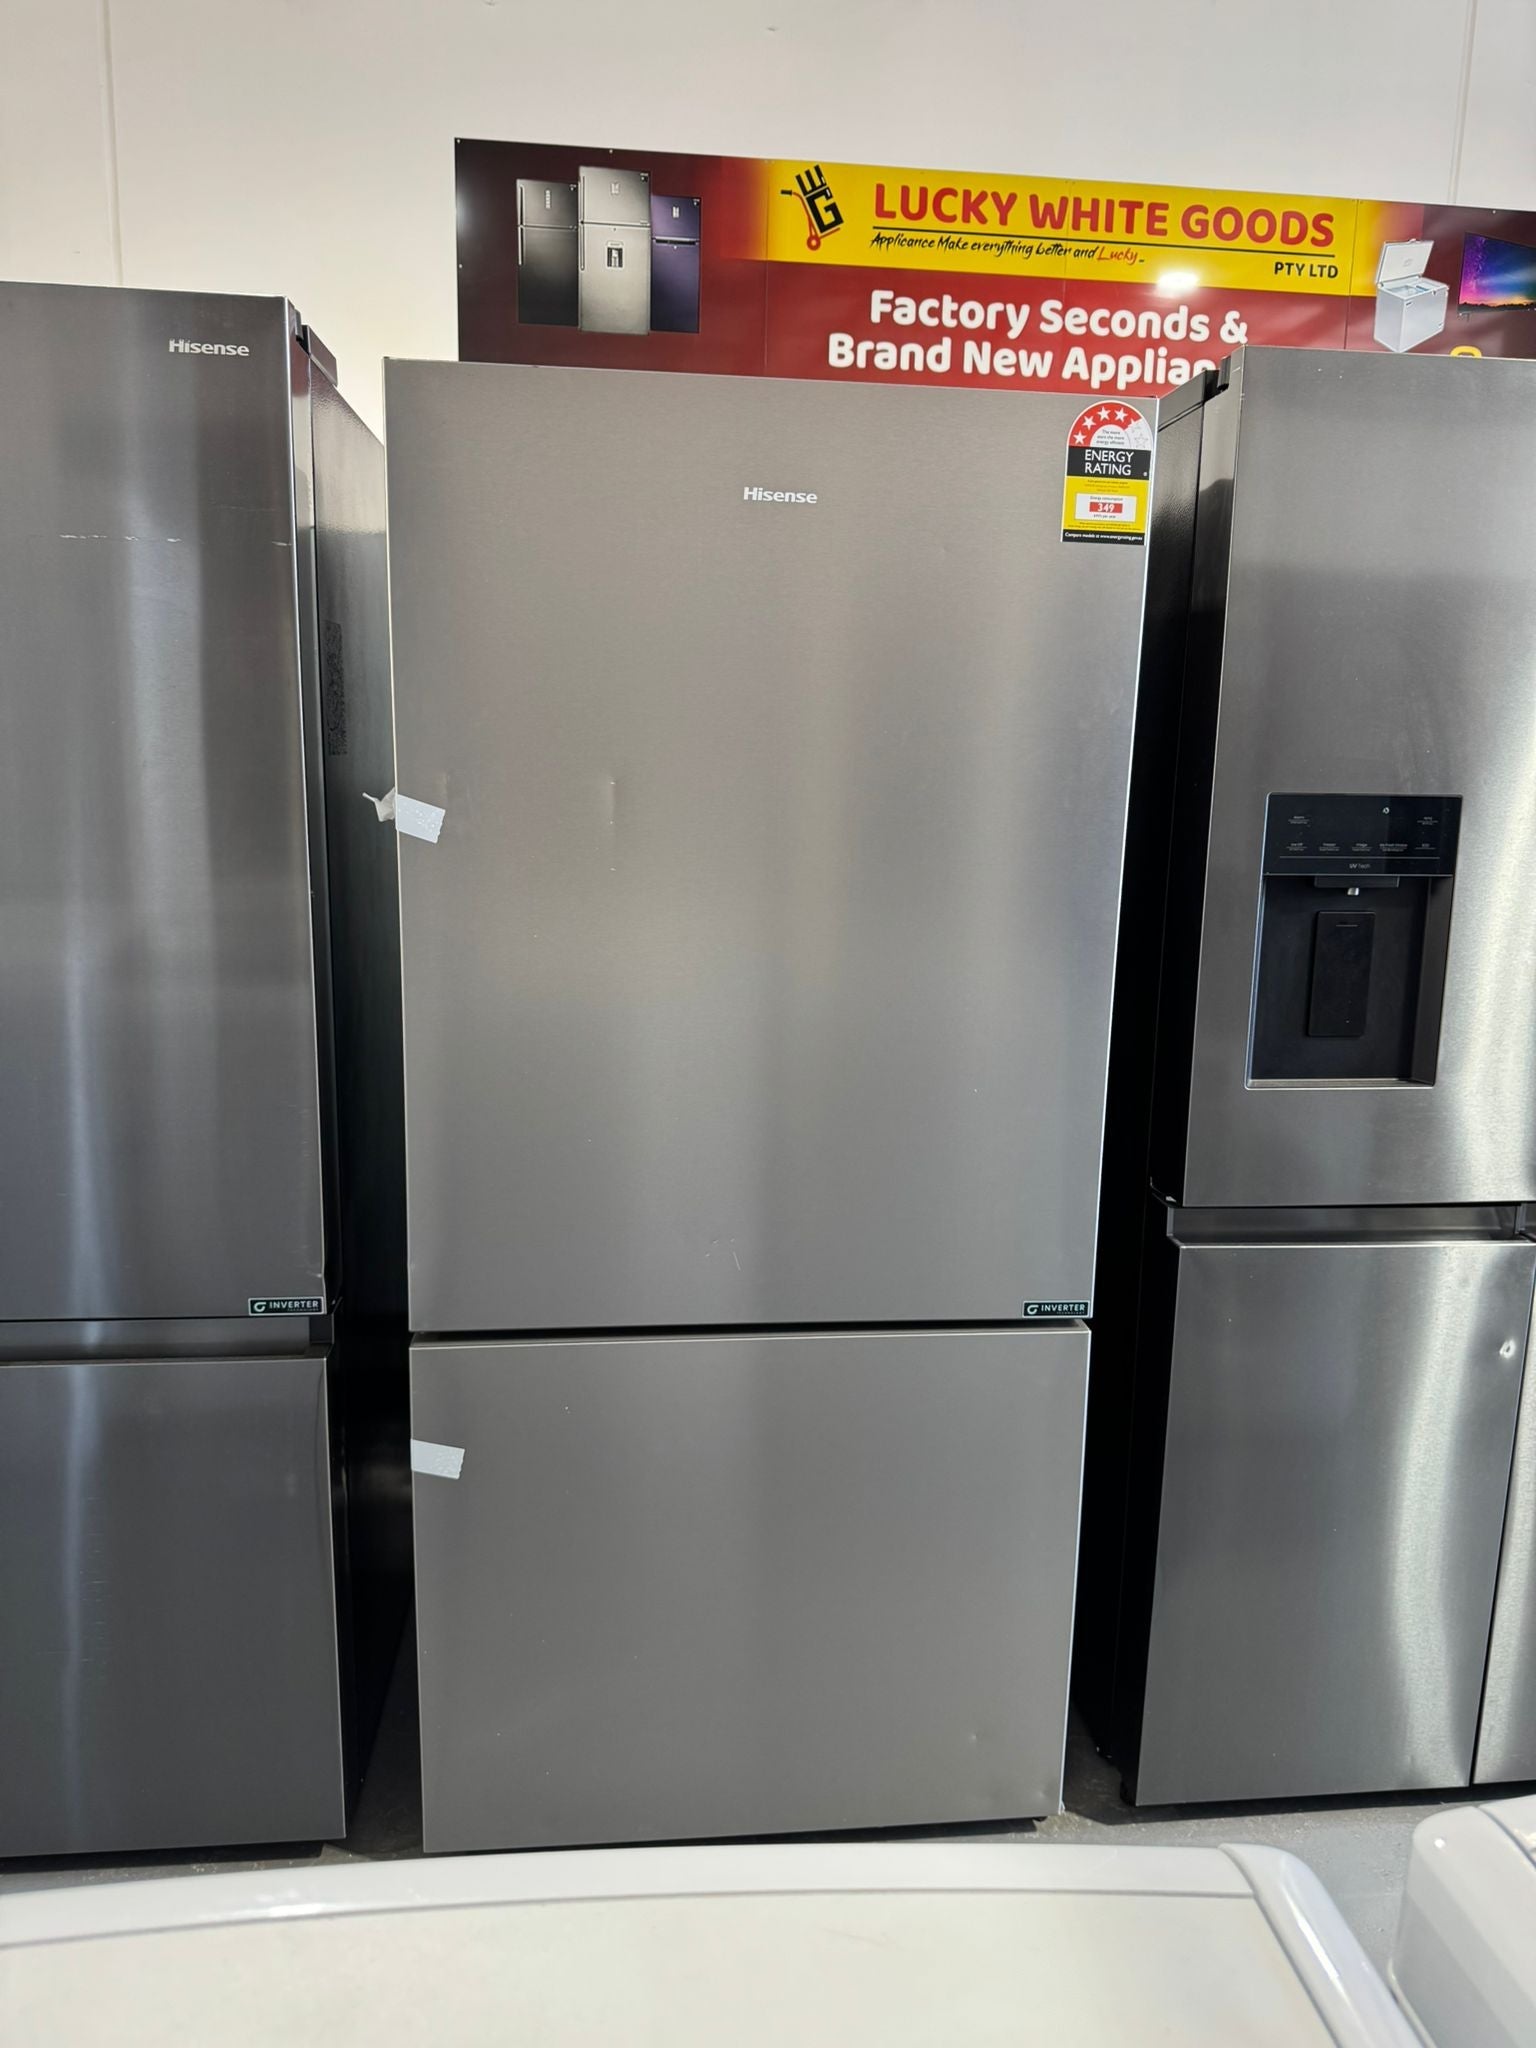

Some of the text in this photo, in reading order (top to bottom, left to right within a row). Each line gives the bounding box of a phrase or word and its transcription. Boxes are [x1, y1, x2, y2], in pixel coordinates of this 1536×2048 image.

[874, 183, 1335, 248] LUCKY WHITE GOODS
[937, 235, 968, 253] Make
[971, 240, 1034, 259] everything
[1035, 242, 1072, 257] better
[1073, 245, 1099, 259] and
[1274, 261, 1339, 279] PTY LTD
[870, 288, 1249, 345] Factory Seconds &
[168, 338, 250, 357] Hisense
[828, 332, 952, 374] Brand
[963, 340, 1054, 379] New
[1084, 449, 1135, 463] ENERGY
[1084, 462, 1132, 476] RATING
[743, 486, 818, 504] Hisense
[1097, 503, 1115, 513] 349
[269, 1300, 319, 1308] INVERTER
